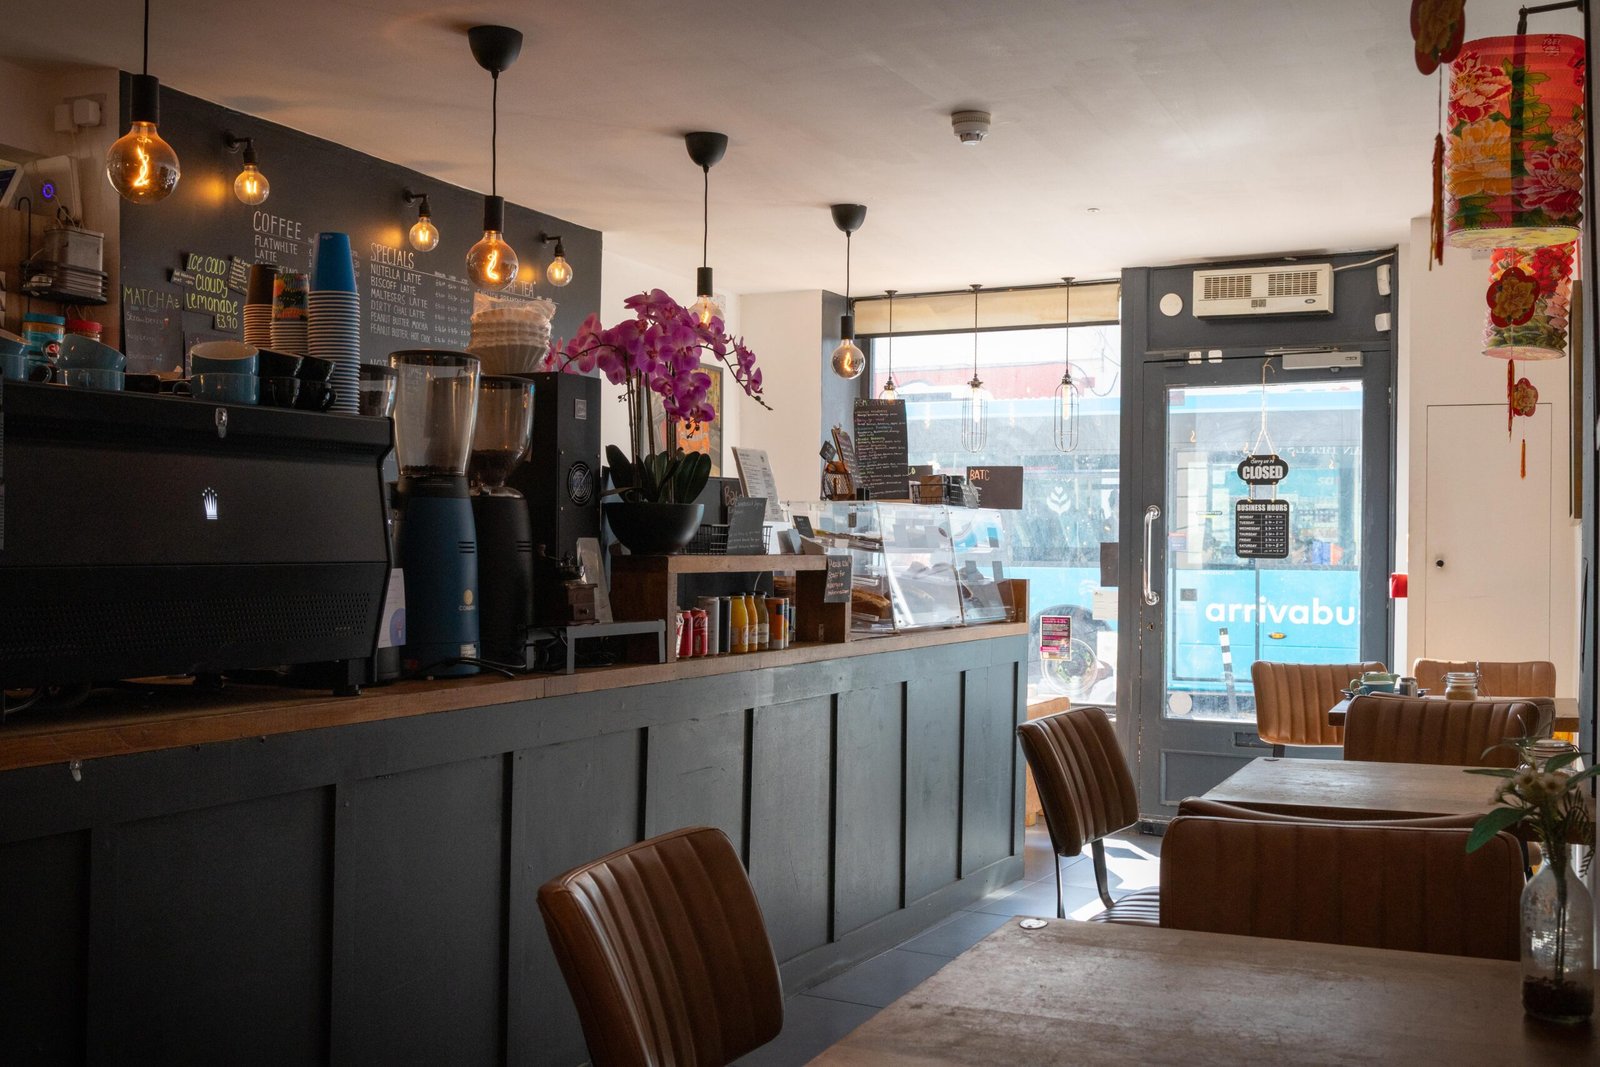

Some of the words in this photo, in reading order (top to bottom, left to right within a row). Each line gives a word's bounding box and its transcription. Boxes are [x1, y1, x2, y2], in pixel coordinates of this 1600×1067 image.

[253, 210, 302, 241] COFFEE
[254, 234, 298, 256] FLATWHITE
[254, 248, 278, 263] LATTE
[370, 242, 415, 270] SPECIALS
[370, 263, 401, 281] NUTELLA
[403, 271, 422, 287] LATTE
[370, 276, 397, 291] BISCOFF
[400, 283, 417, 296] LATTE
[123, 286, 176, 310] MATCHA
[370, 288, 406, 306] MALTESERS
[409, 299, 428, 309] LATTE
[370, 300, 391, 313] DIRTY
[409, 308, 426, 320] LATTE
[370, 312, 391, 326] PEANUT
[392, 316, 410, 328] BUTTER
[217, 313, 240, 330] £3.90
[370, 323, 391, 337] PEANUT
[1242, 465, 1283, 480] CLOSED
[1236, 503, 1266, 513] BUSINESS
[1266, 503, 1288, 513] HOURS
[1205, 596, 1360, 626] arrivabu
